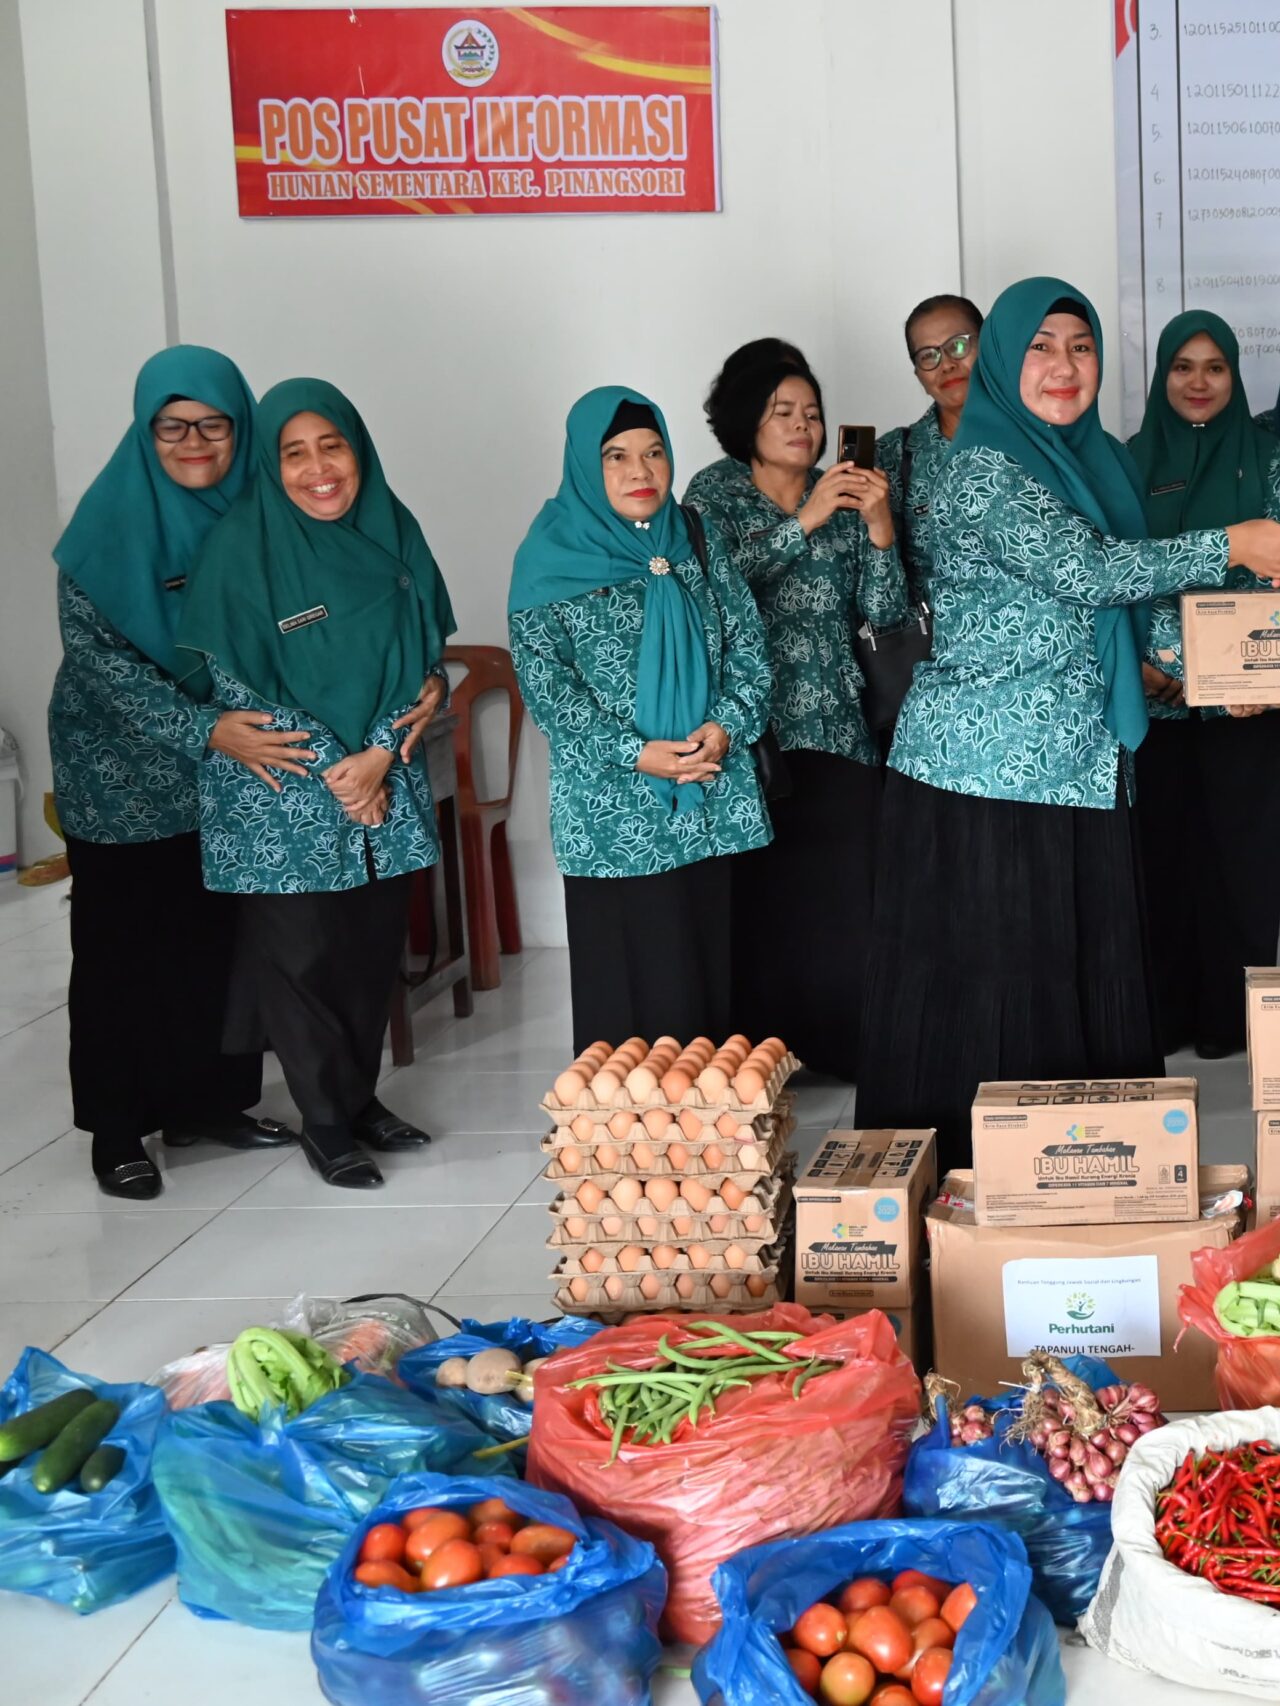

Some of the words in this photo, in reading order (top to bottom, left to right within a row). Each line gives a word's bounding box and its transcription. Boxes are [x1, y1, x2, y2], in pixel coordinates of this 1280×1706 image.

[260, 99, 342, 164] POS
[346, 98, 470, 163] PUSAT
[474, 96, 687, 162] INFORMASI
[268, 172, 353, 199] HUNIAN
[357, 170, 487, 198] SEMENTARA
[490, 170, 540, 197] KEC.
[546, 169, 684, 197] PINANGSORI
[1241, 640, 1271, 657] IBU
[1055, 1145, 1083, 1154] Makanan
[1086, 1144, 1116, 1153] Tambahan
[1034, 1157, 1068, 1175] IBU
[1073, 1156, 1140, 1174] HAMIL
[1177, 1170, 1183, 1179] 4
[801, 1253, 834, 1269] IBU
[837, 1253, 900, 1269] HAMIL
[1049, 1323, 1114, 1334] Perhutani
